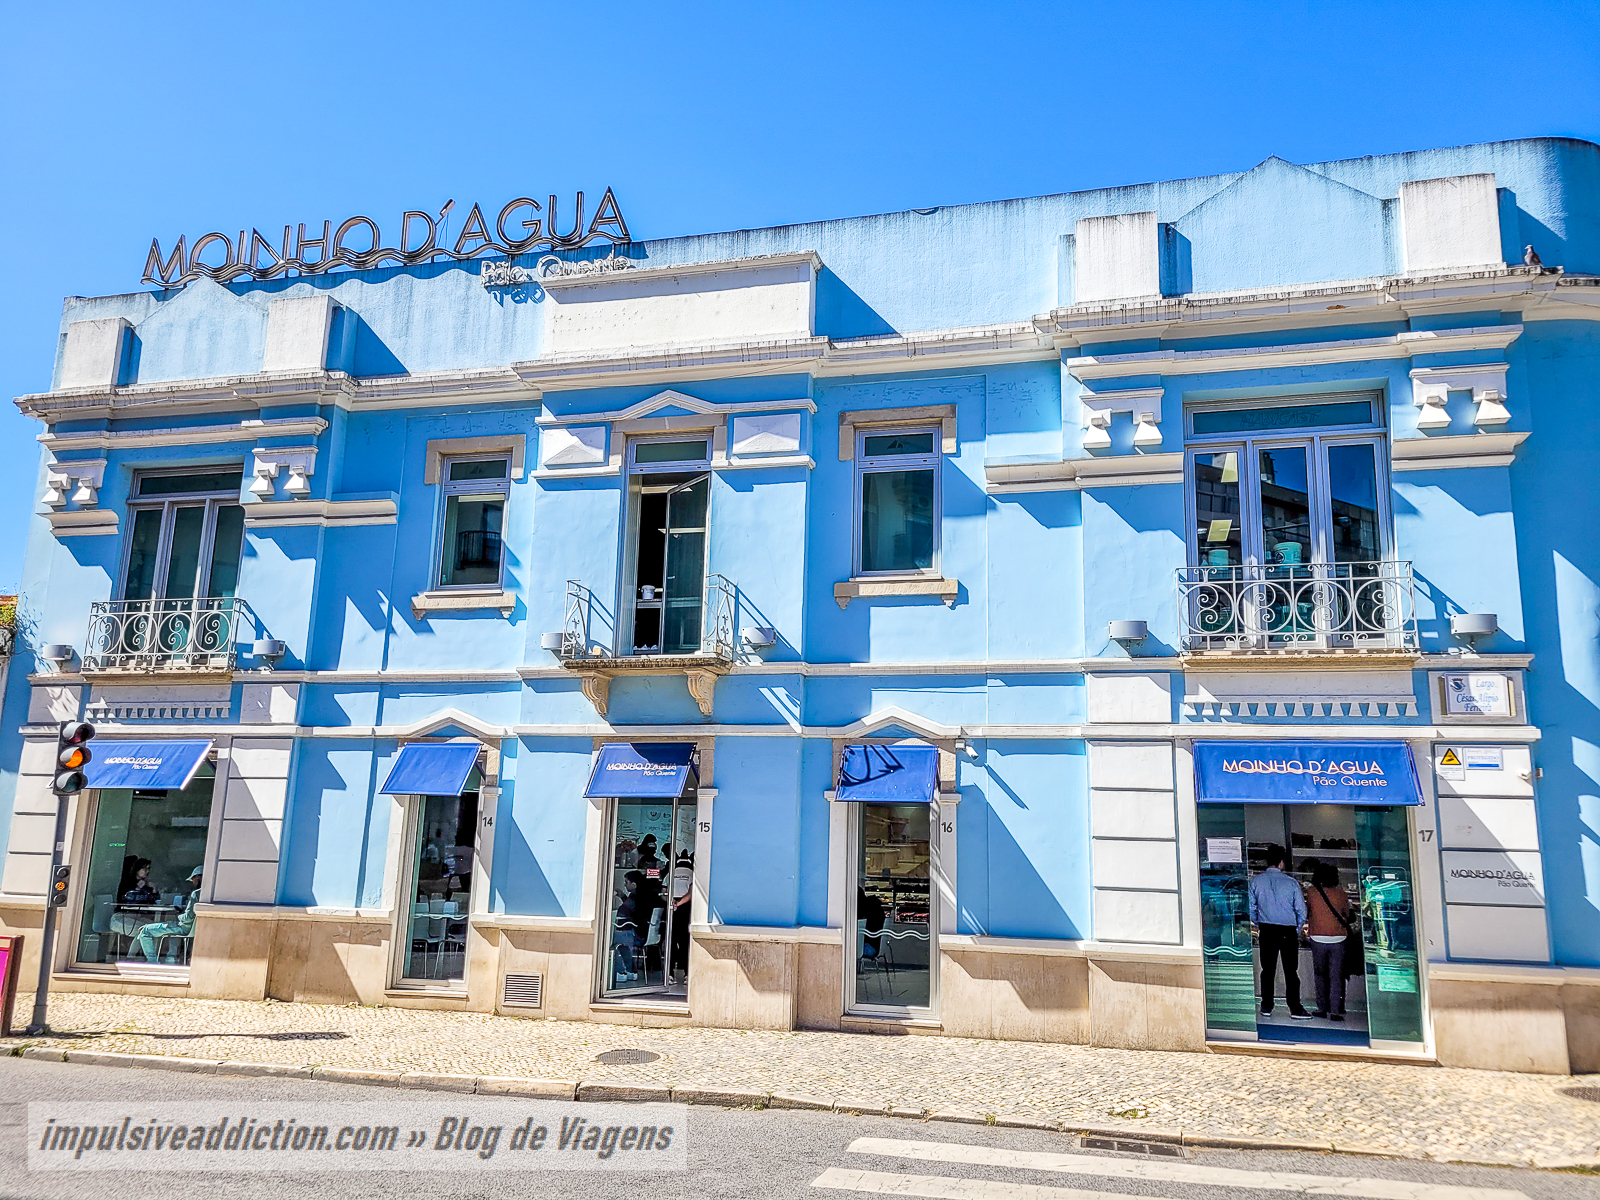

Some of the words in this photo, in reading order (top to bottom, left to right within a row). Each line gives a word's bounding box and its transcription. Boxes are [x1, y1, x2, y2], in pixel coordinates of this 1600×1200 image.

[141, 215, 381, 284] MOINHO
[606, 762, 643, 770] MOINHO
[1222, 759, 1303, 775] MOINHO
[1312, 775, 1338, 786] Pão
[1340, 775, 1388, 787] Quente
[482, 816, 493, 827] 14
[698, 821, 710, 833] 15
[941, 821, 953, 833] 16
[1418, 829, 1434, 843] 17
[1450, 868, 1495, 879] MOINHO
[1497, 880, 1511, 888] Pão
